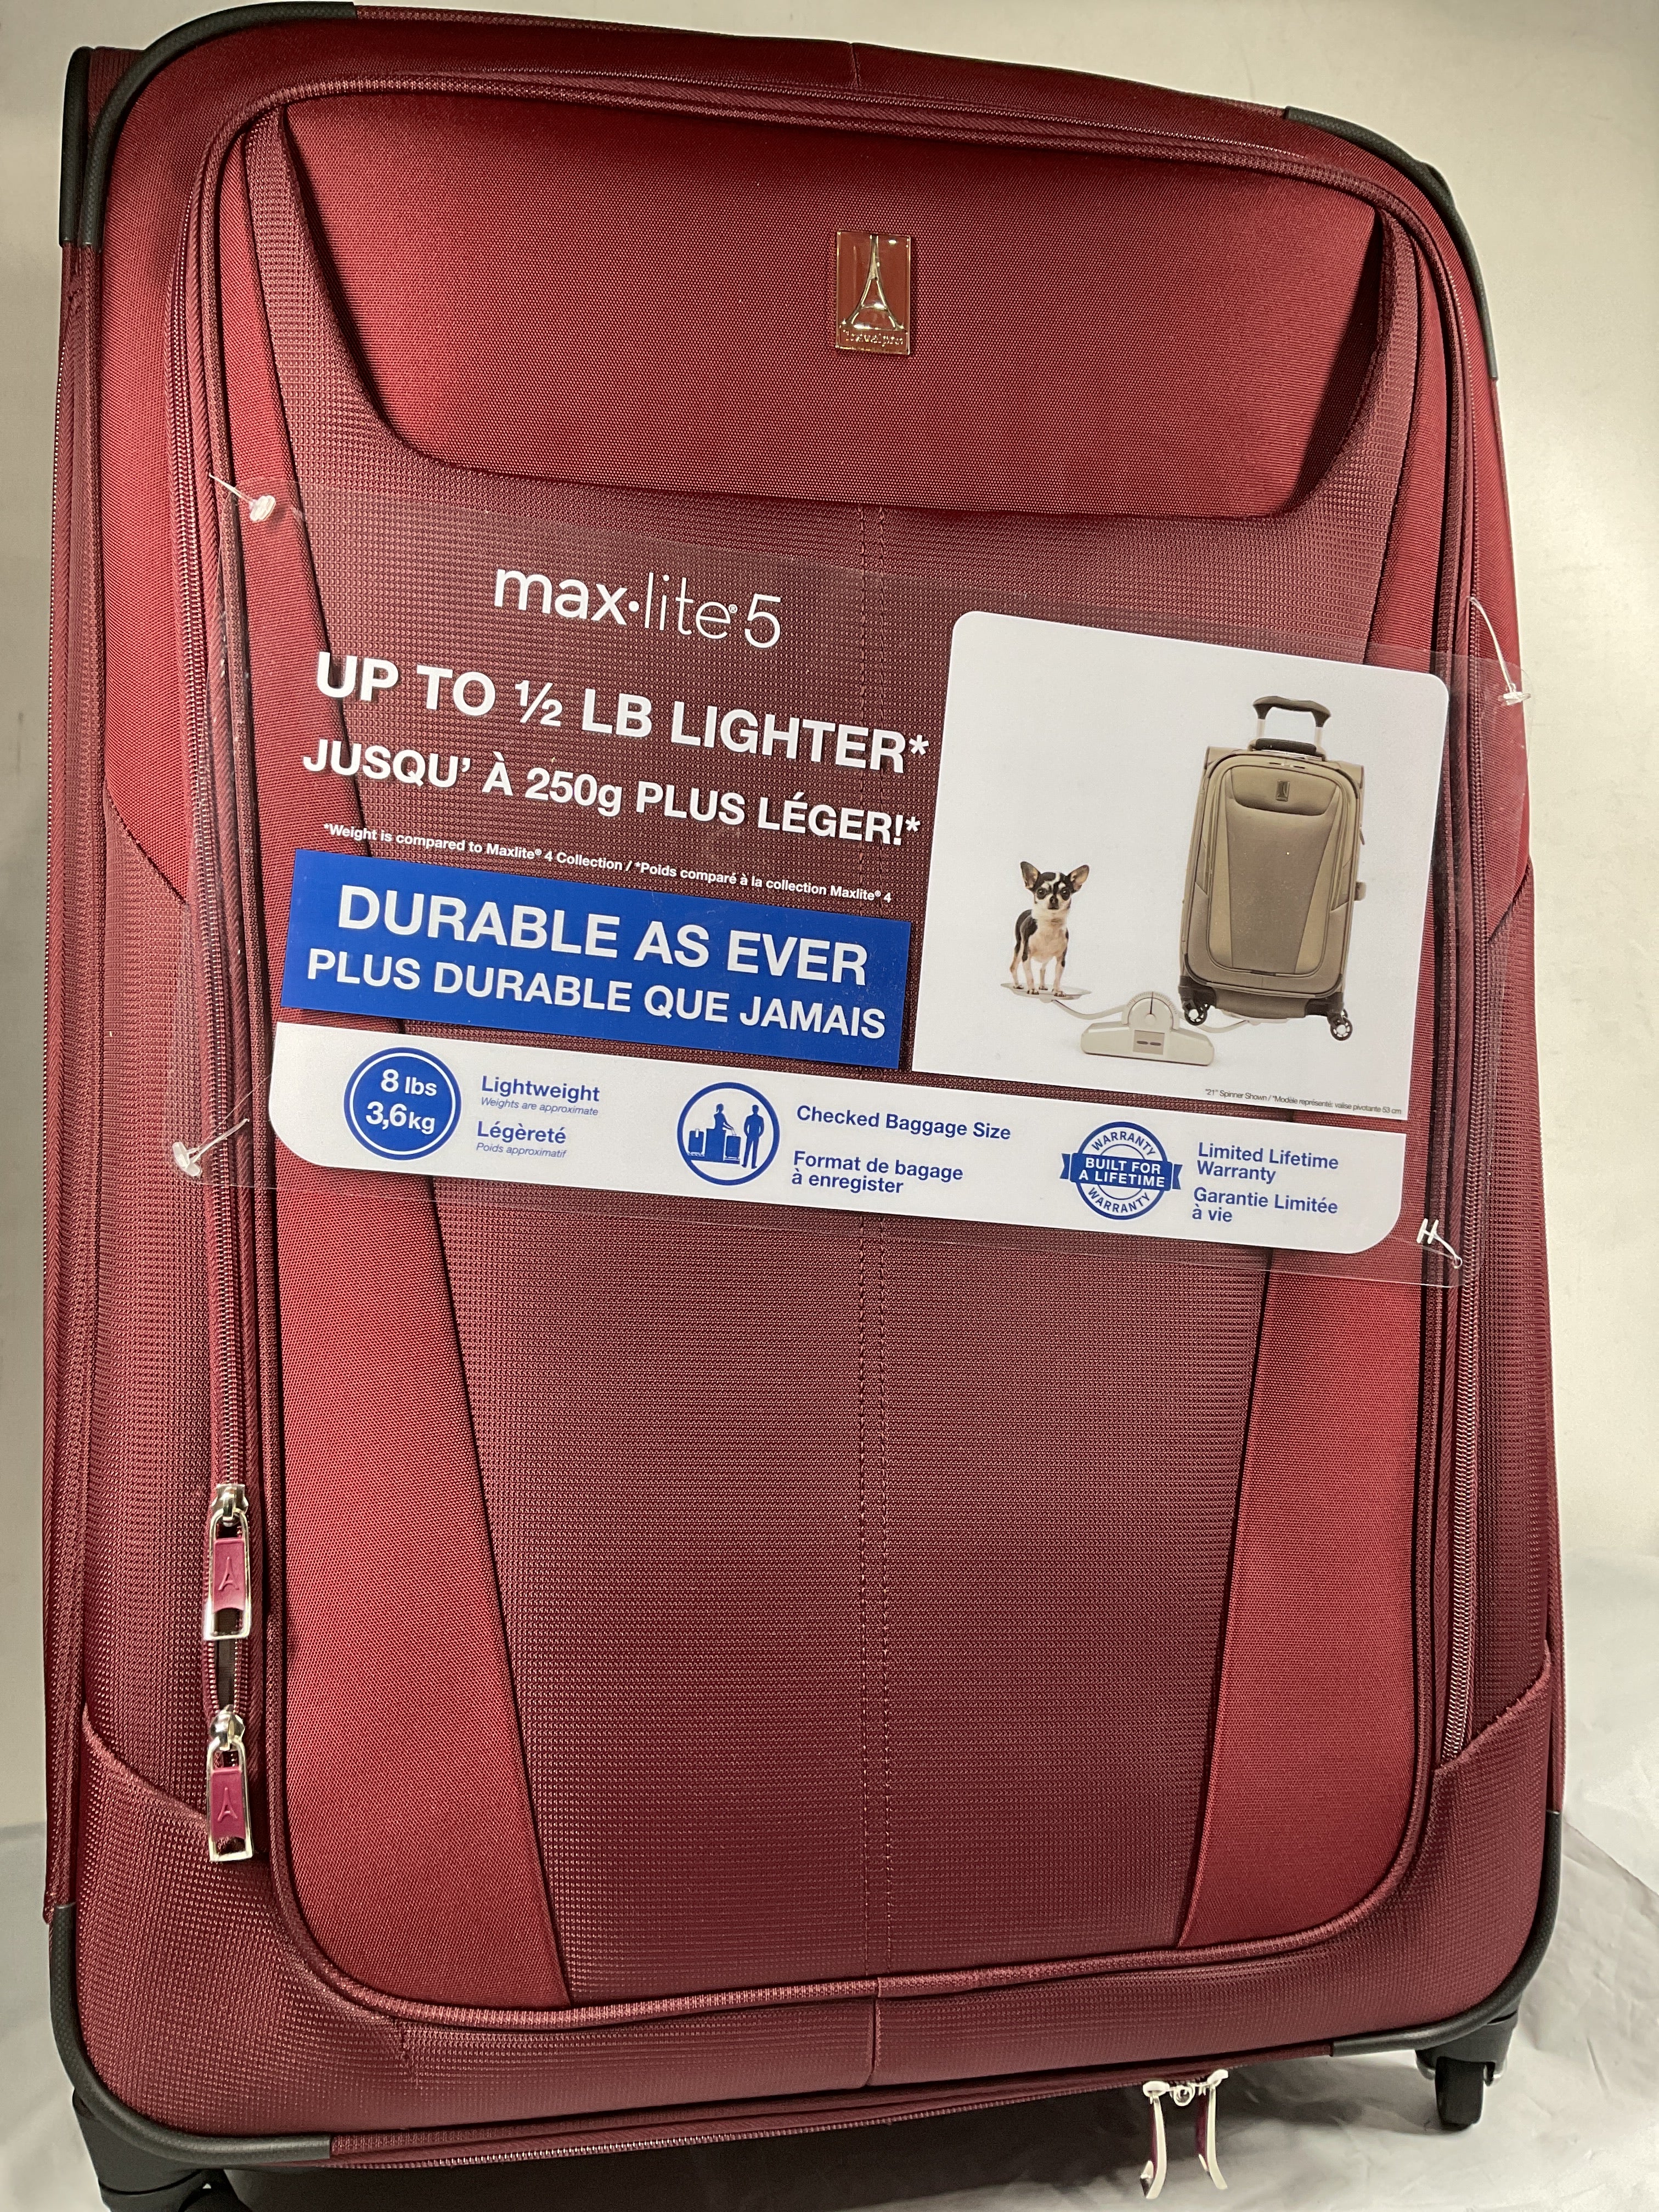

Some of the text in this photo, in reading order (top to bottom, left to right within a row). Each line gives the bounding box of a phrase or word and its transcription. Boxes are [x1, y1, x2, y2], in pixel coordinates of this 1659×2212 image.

[317, 651, 399, 702] UP
[416, 664, 496, 716] TO
[582, 688, 653, 738] LB
[482, 751, 513, 796] À
[525, 767, 623, 817] 250g
[636, 781, 746, 826] PLUS
[381, 830, 392, 842] is
[396, 834, 465, 851] compared
[469, 840, 483, 853] to
[544, 851, 553, 862] 4
[556, 852, 624, 871] Collection
[680, 868, 737, 884] comparé
[740, 874, 748, 887] à
[752, 876, 762, 888] la
[766, 878, 827, 895] collection
[883, 893, 892, 904] 4
[338, 884, 868, 986] DURABLE AS EVER
[308, 948, 886, 1039] PLUS DURABLE QUE JAMAIS
[381, 1069, 437, 1097] 8 lbs
[482, 1075, 600, 1103] Lightweight
[1220, 1090, 1244, 1099] Spinner
[1245, 1092, 1267, 1102] Shown
[481, 1097, 518, 1110] Weights
[539, 1103, 599, 1116] approximate
[477, 1121, 566, 1144] Légèreté
[797, 1105, 1012, 1140] Checked Baggage Size
[476, 1142, 567, 1159] Poids approximatif
[1092, 1131, 1156, 1155] WARRANTY
[1199, 1142, 1339, 1170] Limited Lifetime
[793, 1151, 964, 1182] Format de bagage
[1079, 1170, 1165, 1187] A LIFETIME
[1086, 1158, 1161, 1175] BUILT FOR
[1197, 1160, 1277, 1184] Warranty
[792, 1168, 904, 1194] à enregister
[1088, 1187, 1150, 1213] WARRANTY
[1192, 1204, 1233, 1222] à vie
[1194, 1187, 1338, 1214] Garantie Limitée
